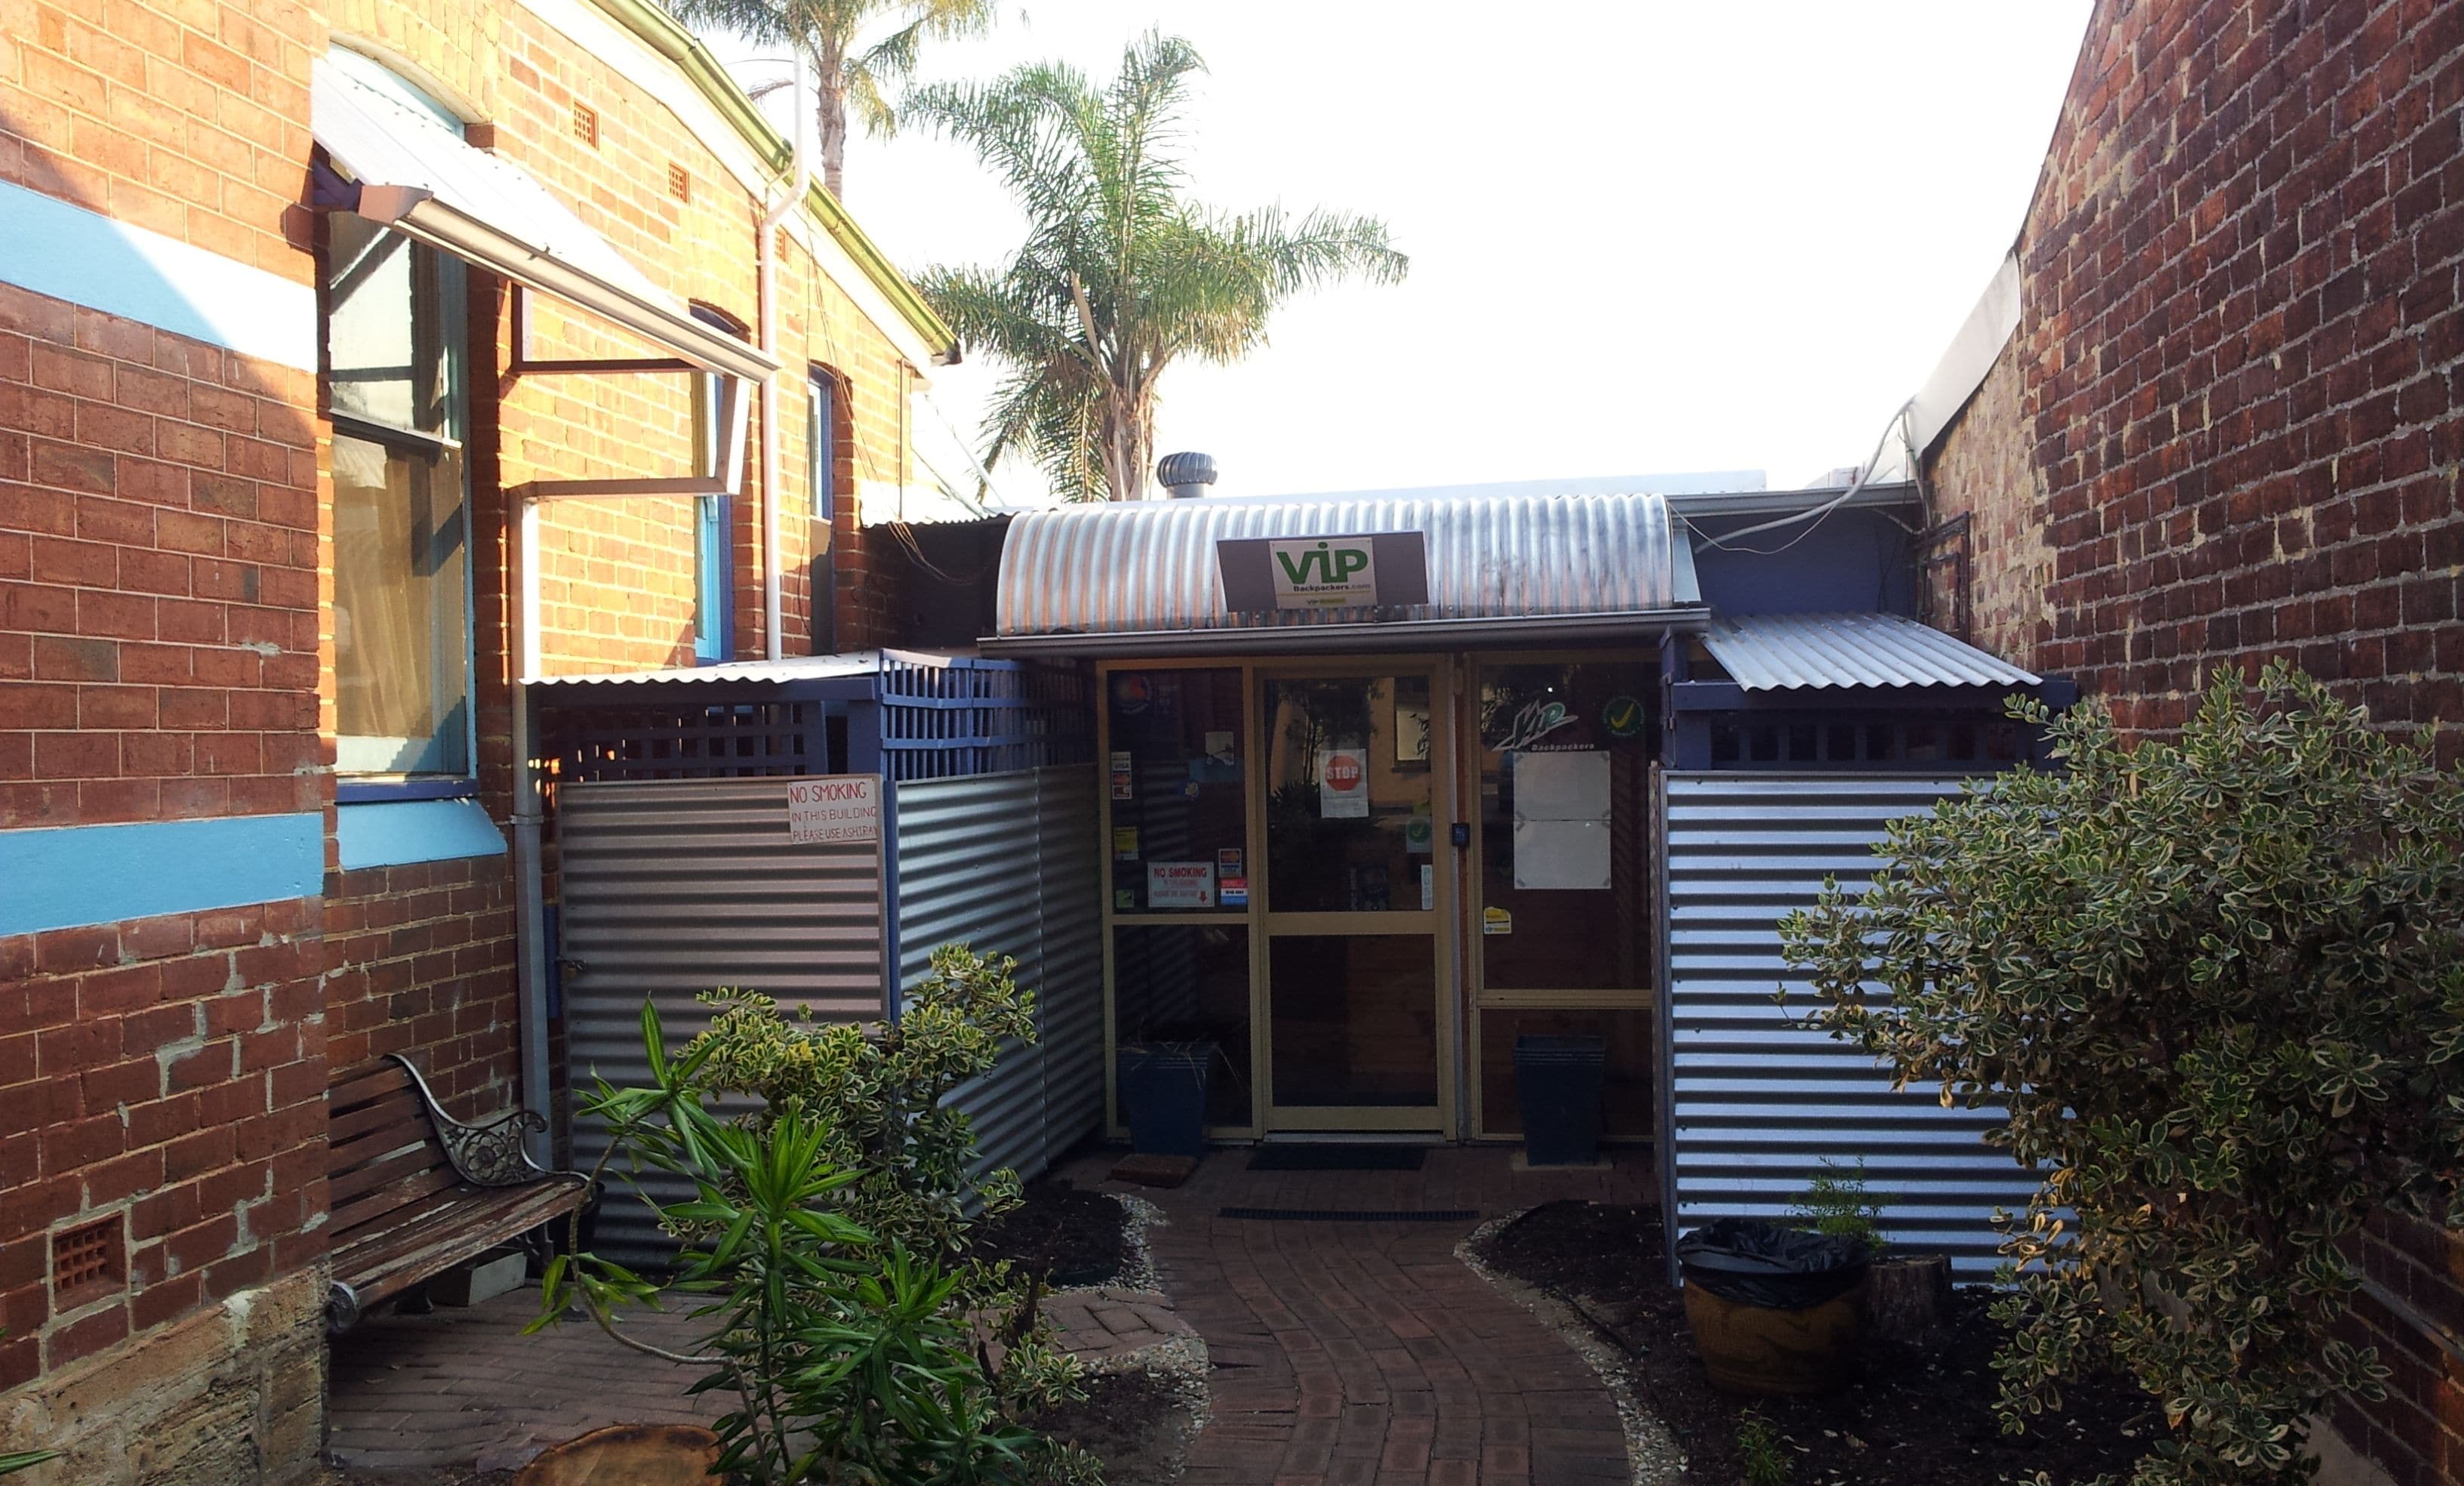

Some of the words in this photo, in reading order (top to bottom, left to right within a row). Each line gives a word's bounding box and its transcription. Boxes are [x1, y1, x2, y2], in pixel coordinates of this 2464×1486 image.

[1531, 743, 1595, 751] Backpackers
[1326, 766, 1359, 780] STOP
[790, 787, 808, 804] NO
[812, 782, 867, 803] SMOKING
[791, 812, 802, 822] IN
[804, 810, 827, 821] THIS
[829, 806, 876, 820] BUILDING
[793, 829, 824, 841] PLEASE
[826, 828, 840, 839] USE
[1153, 868, 1166, 878] NO
[1169, 867, 1207, 878] SMOKING
